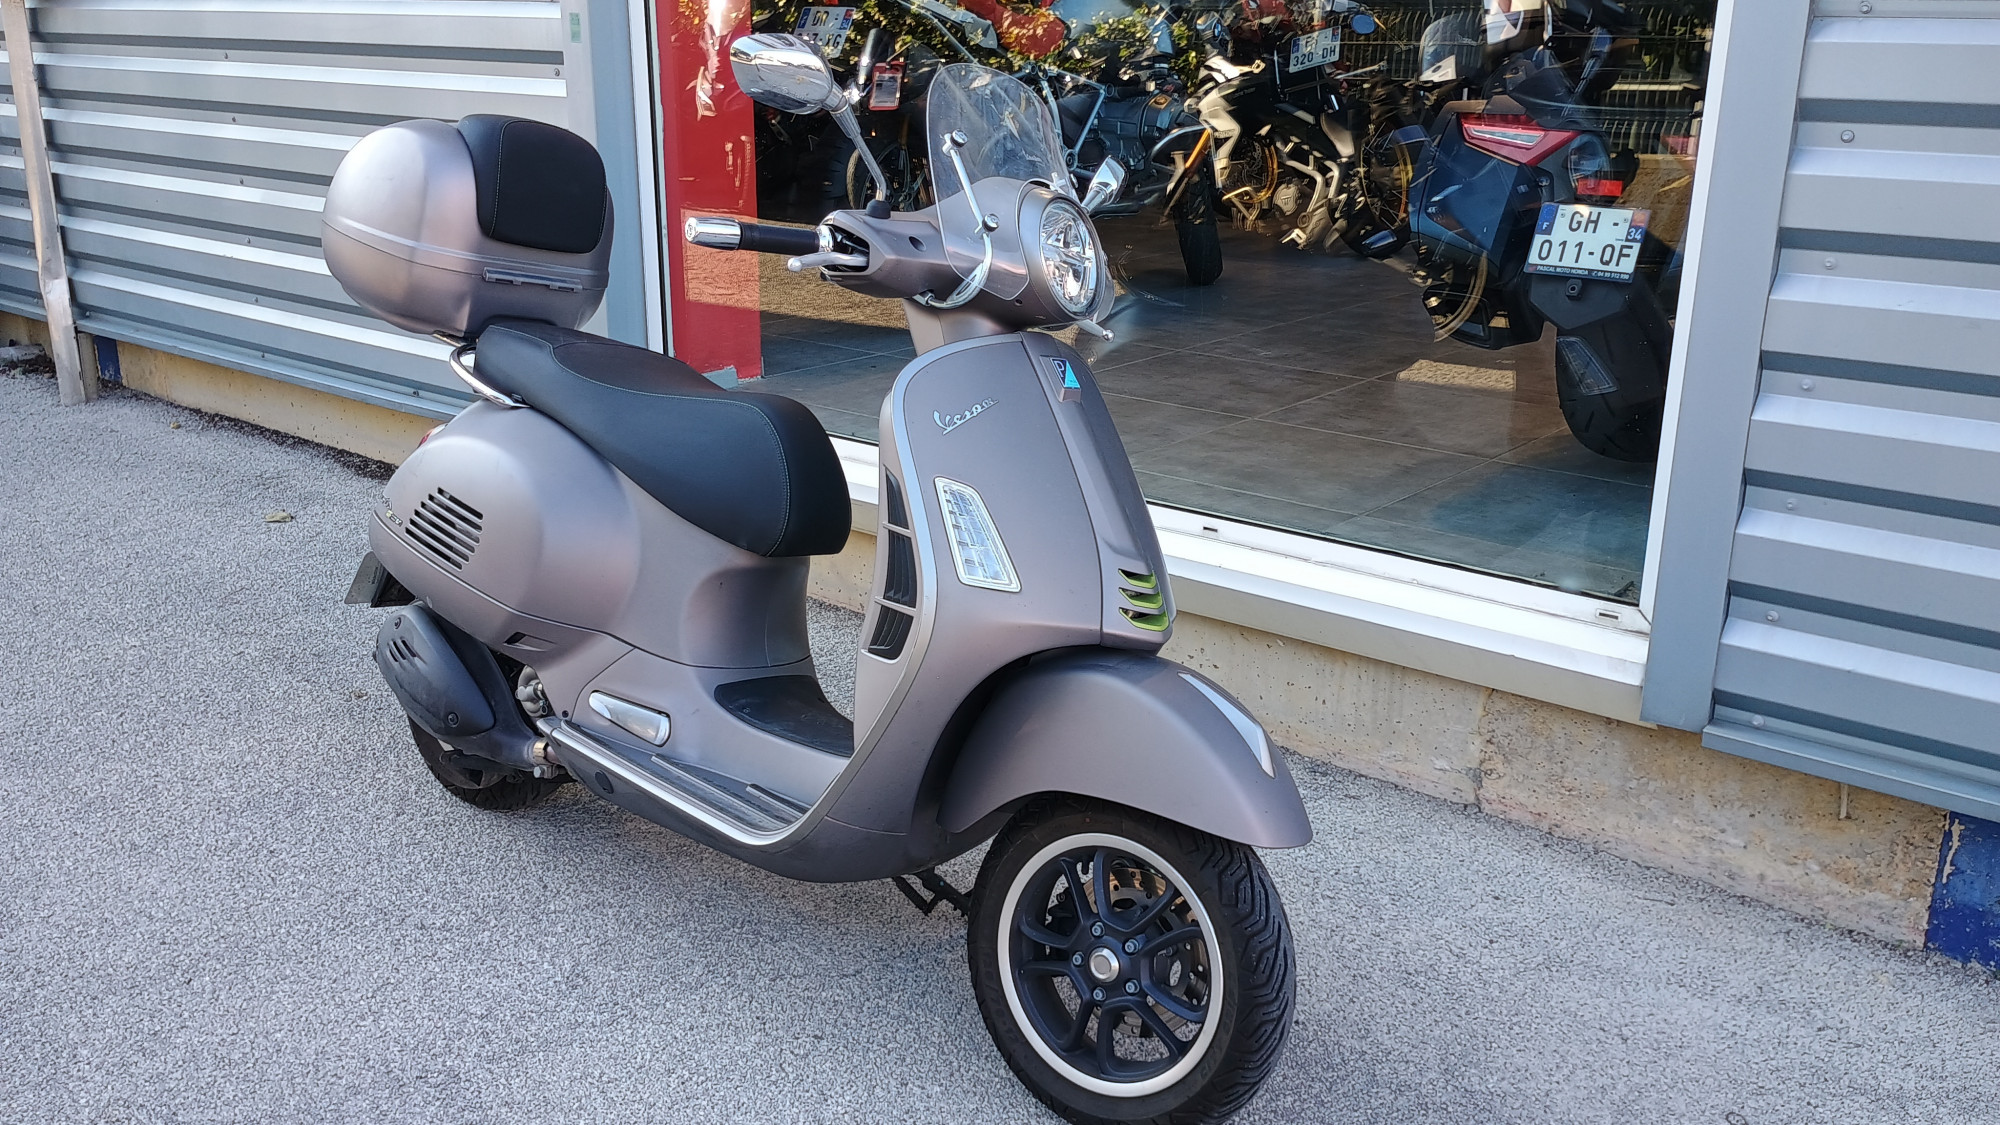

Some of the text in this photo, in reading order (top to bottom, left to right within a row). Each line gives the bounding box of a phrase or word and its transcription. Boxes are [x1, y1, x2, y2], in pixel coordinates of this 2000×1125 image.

[1627, 227, 1642, 241] 34
[1537, 239, 1634, 267] 011-QF
[933, 397, 999, 436] Vespa
